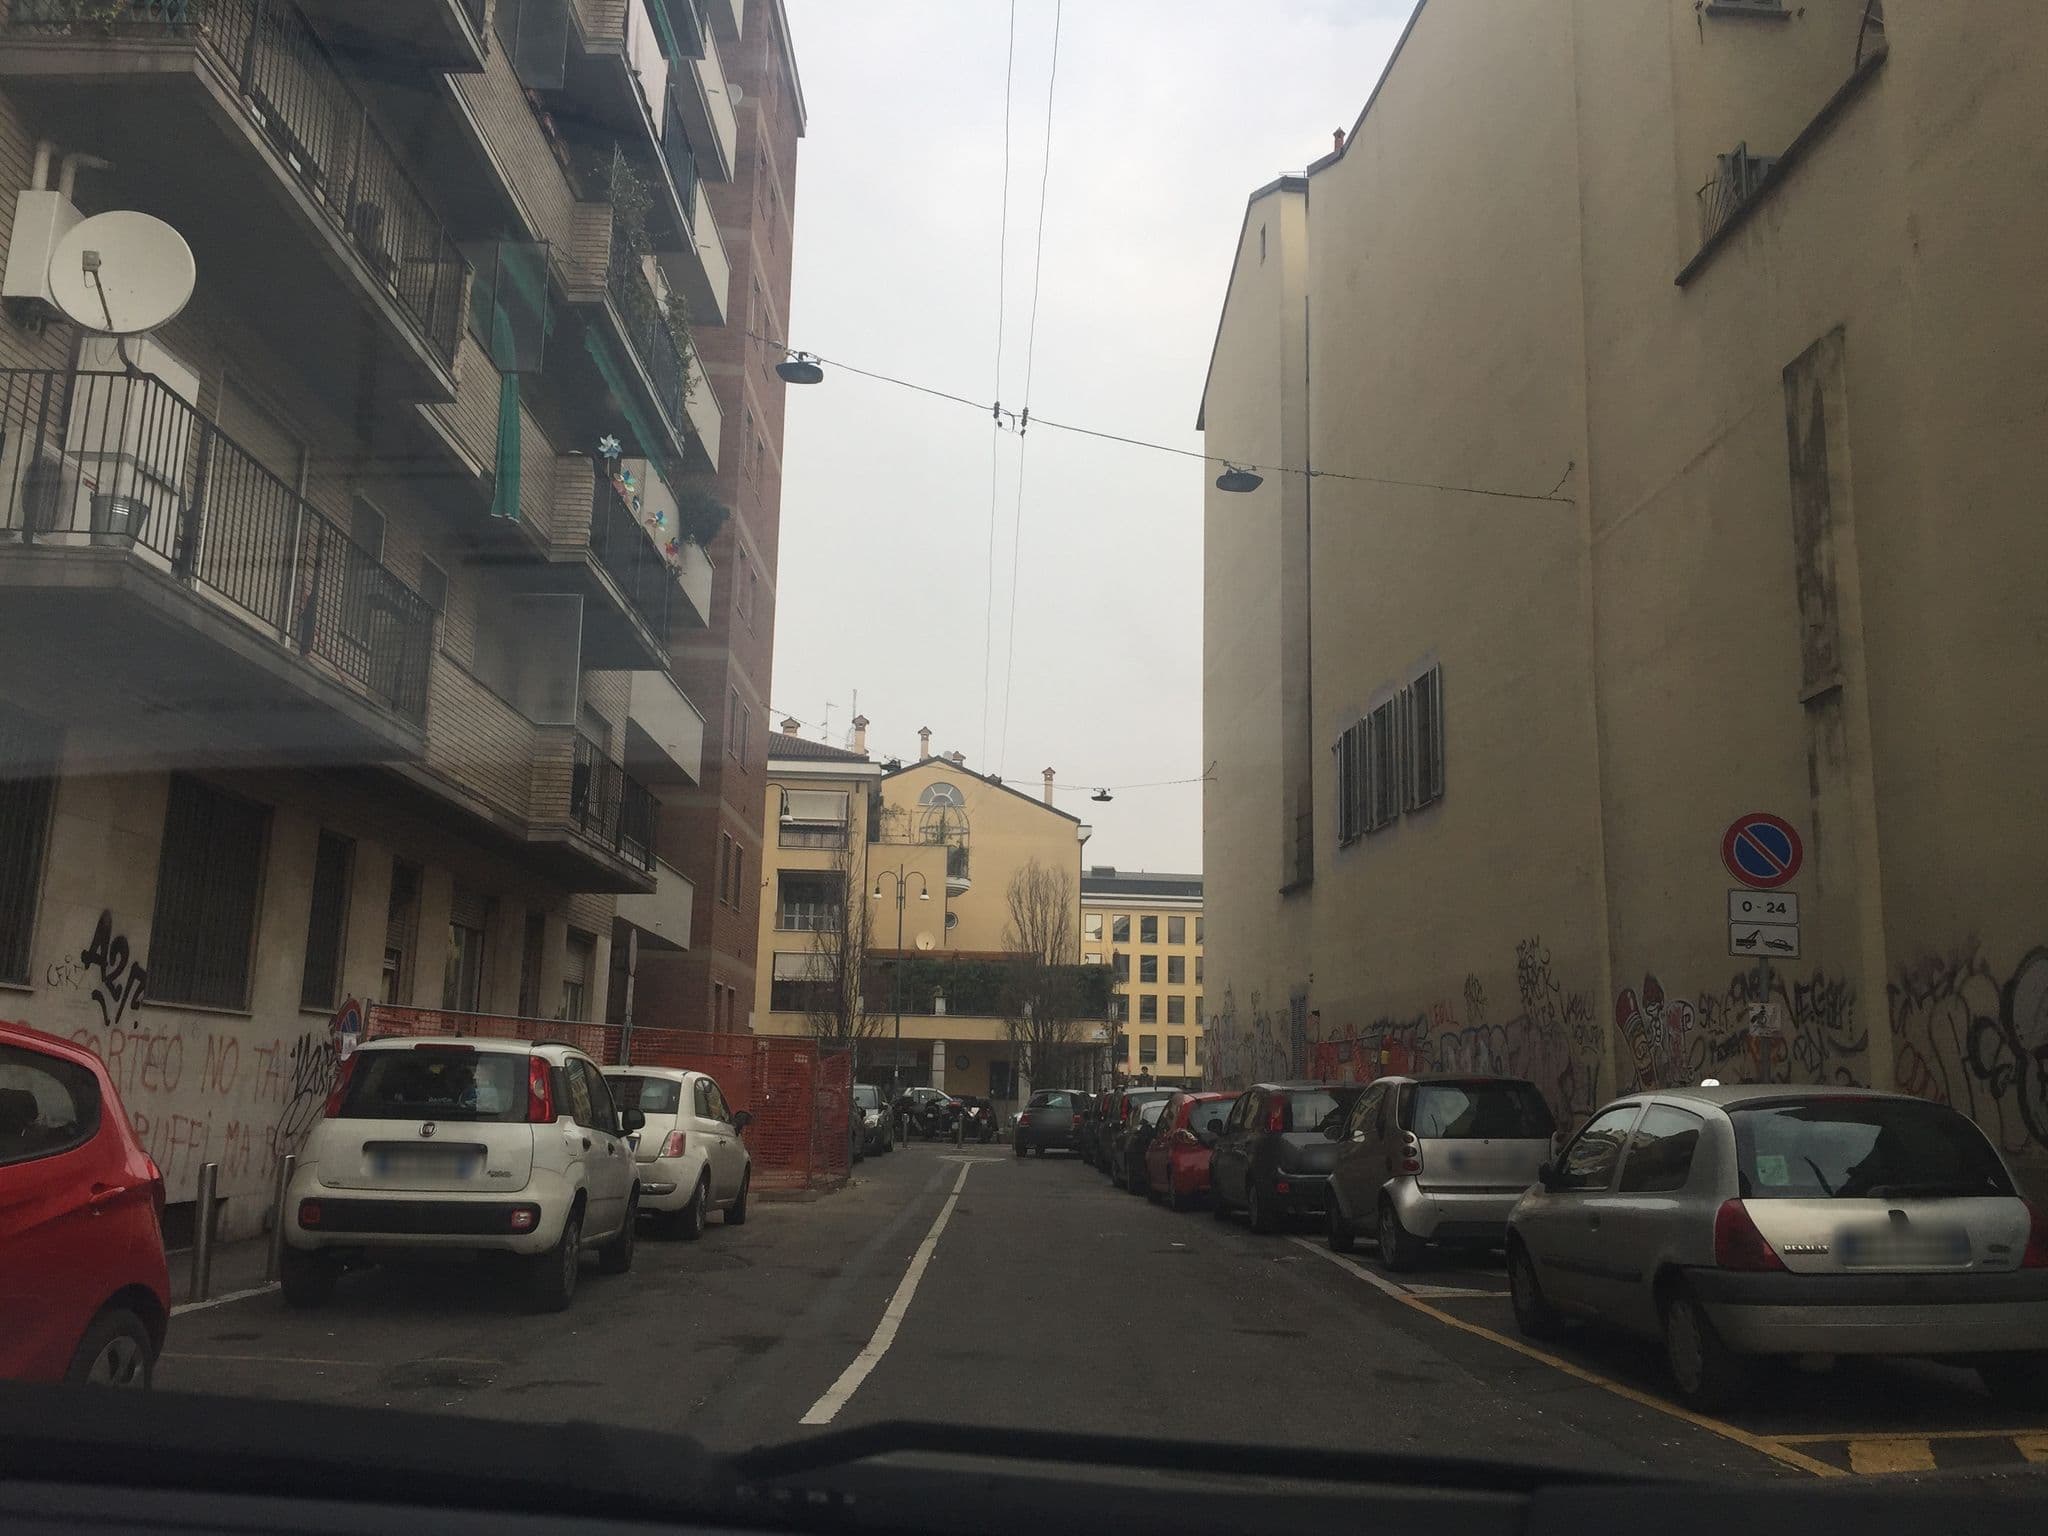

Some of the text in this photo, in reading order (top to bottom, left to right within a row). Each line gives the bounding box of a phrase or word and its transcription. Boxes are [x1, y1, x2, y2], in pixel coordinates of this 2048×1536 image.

[1766, 902, 1787, 914] 24
[71, 1029, 183, 1093] RTEO
[201, 1034, 239, 1094] NO
